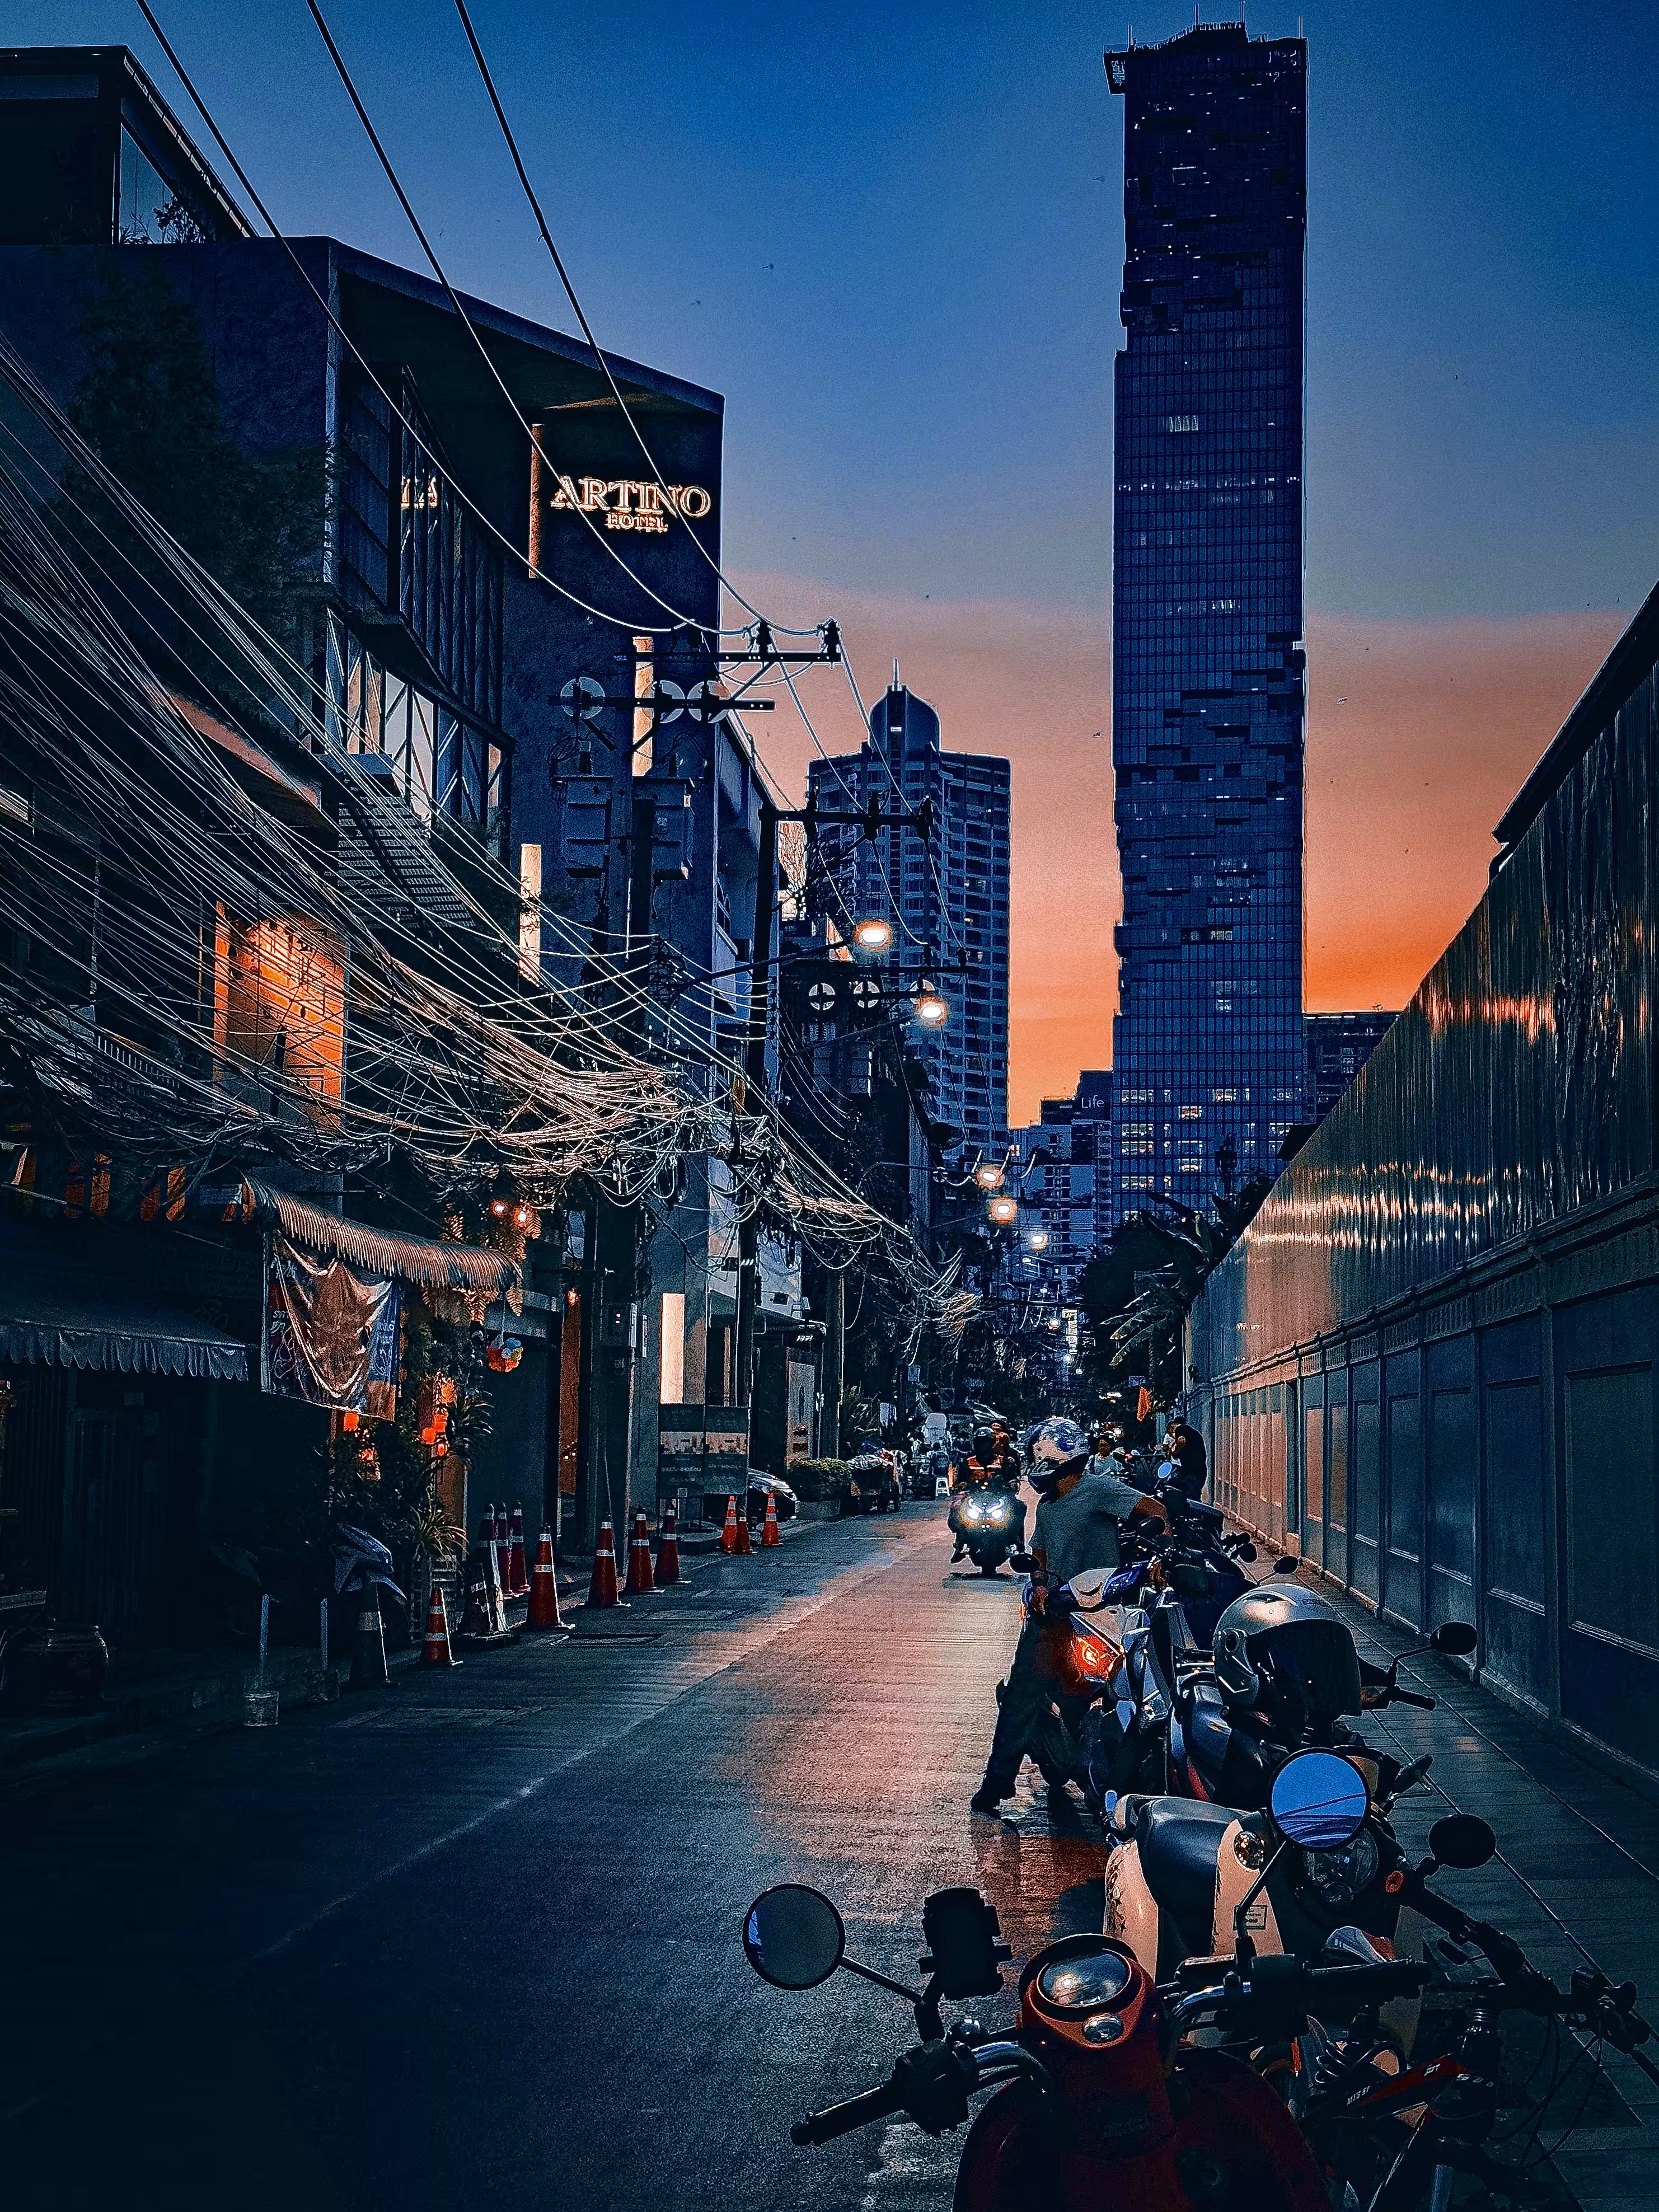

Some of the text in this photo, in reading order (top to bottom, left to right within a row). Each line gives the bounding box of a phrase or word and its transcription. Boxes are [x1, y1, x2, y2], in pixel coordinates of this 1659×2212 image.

[550, 475, 711, 518] ARTINO
[605, 512, 668, 532] HOTEL
[1081, 1094, 1104, 1108] Life
